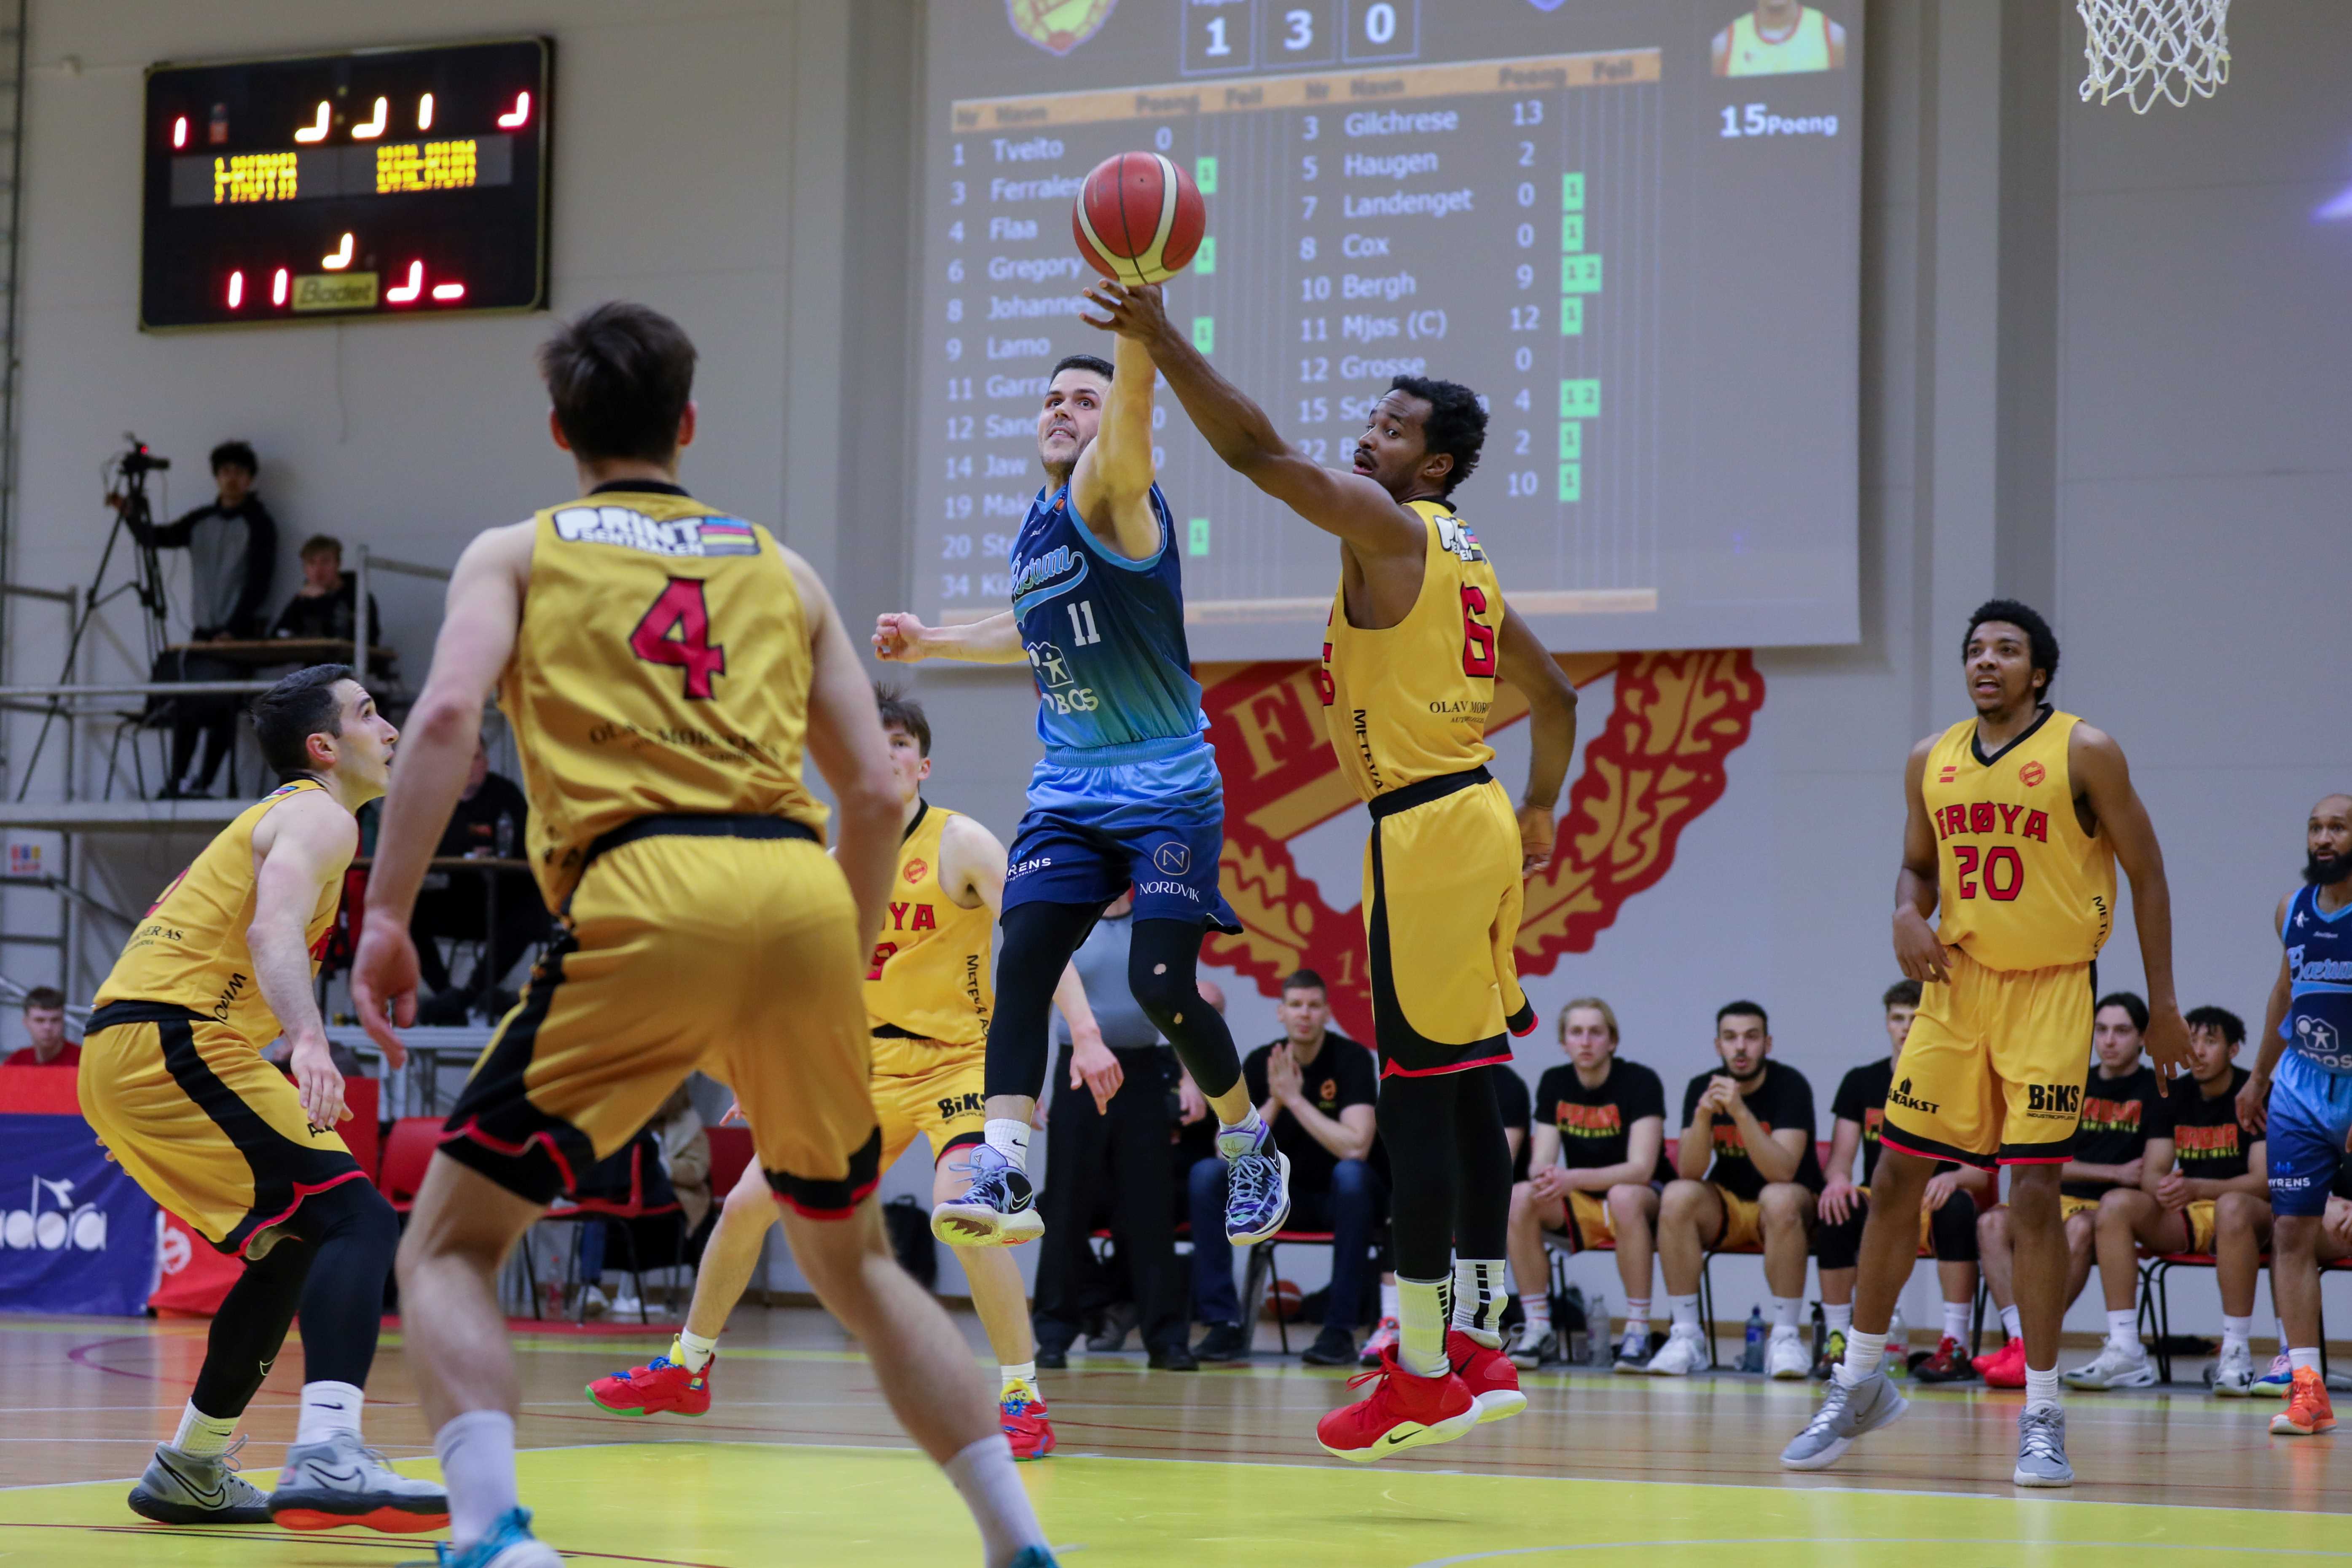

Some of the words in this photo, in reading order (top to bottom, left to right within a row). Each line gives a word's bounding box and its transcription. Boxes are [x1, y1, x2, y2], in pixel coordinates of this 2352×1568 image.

[1206, 16, 1231, 56] 1
[1283, 9, 1313, 51] 3
[1365, 2, 1396, 44] 0
[1303, 117, 1318, 141] 3
[1345, 108, 1459, 137] Gilchrese
[1513, 99, 1544, 126] 13
[953, 143, 965, 166] 1
[992, 137, 1064, 163] Tveito
[1155, 127, 1173, 151] 0
[1303, 156, 1318, 181] 5
[1344, 151, 1438, 180] Haugen
[1519, 141, 1535, 166] 2
[951, 181, 966, 206] 3
[1303, 196, 1318, 220] 7
[1344, 188, 1474, 219] Landenget
[1518, 182, 1535, 207] 0
[948, 220, 964, 243] 4
[1299, 237, 1317, 260] 8
[1342, 234, 1390, 259] Cox
[1517, 223, 1534, 248] 0
[948, 258, 965, 284] 6
[988, 255, 1086, 284] Gregory
[1301, 277, 1331, 302] 10
[1343, 272, 1416, 302] Bergh
[1517, 265, 1533, 290] 9
[946, 298, 964, 324] 8
[1300, 319, 1327, 342] 11
[1511, 306, 1540, 331] 12
[945, 338, 963, 362] 9
[986, 337, 1051, 360] Lamo
[1300, 357, 1327, 382] 12
[1340, 355, 1426, 379] Grosse
[1516, 347, 1532, 372] 0
[948, 379, 973, 401] 11
[1299, 397, 1327, 423] 15
[1514, 388, 1530, 411] 4
[947, 416, 974, 440] 12
[1152, 405, 1166, 430] 0
[1515, 430, 1530, 455] 2
[946, 455, 973, 479] 14
[1152, 446, 1165, 470] 0
[1508, 471, 1538, 496] 10
[945, 495, 972, 520] 19
[553, 506, 703, 545] PRINT
[943, 534, 970, 559] 20
[942, 573, 969, 599] 34
[629, 575, 725, 701] 4
[1067, 600, 1101, 647] 11
[1461, 581, 1495, 678] 6
[1430, 701, 1469, 713] OLAV
[1953, 846, 2024, 901] 20
[1139, 881, 1200, 903] NORDVIK
[0, 1174, 107, 1251] dora
